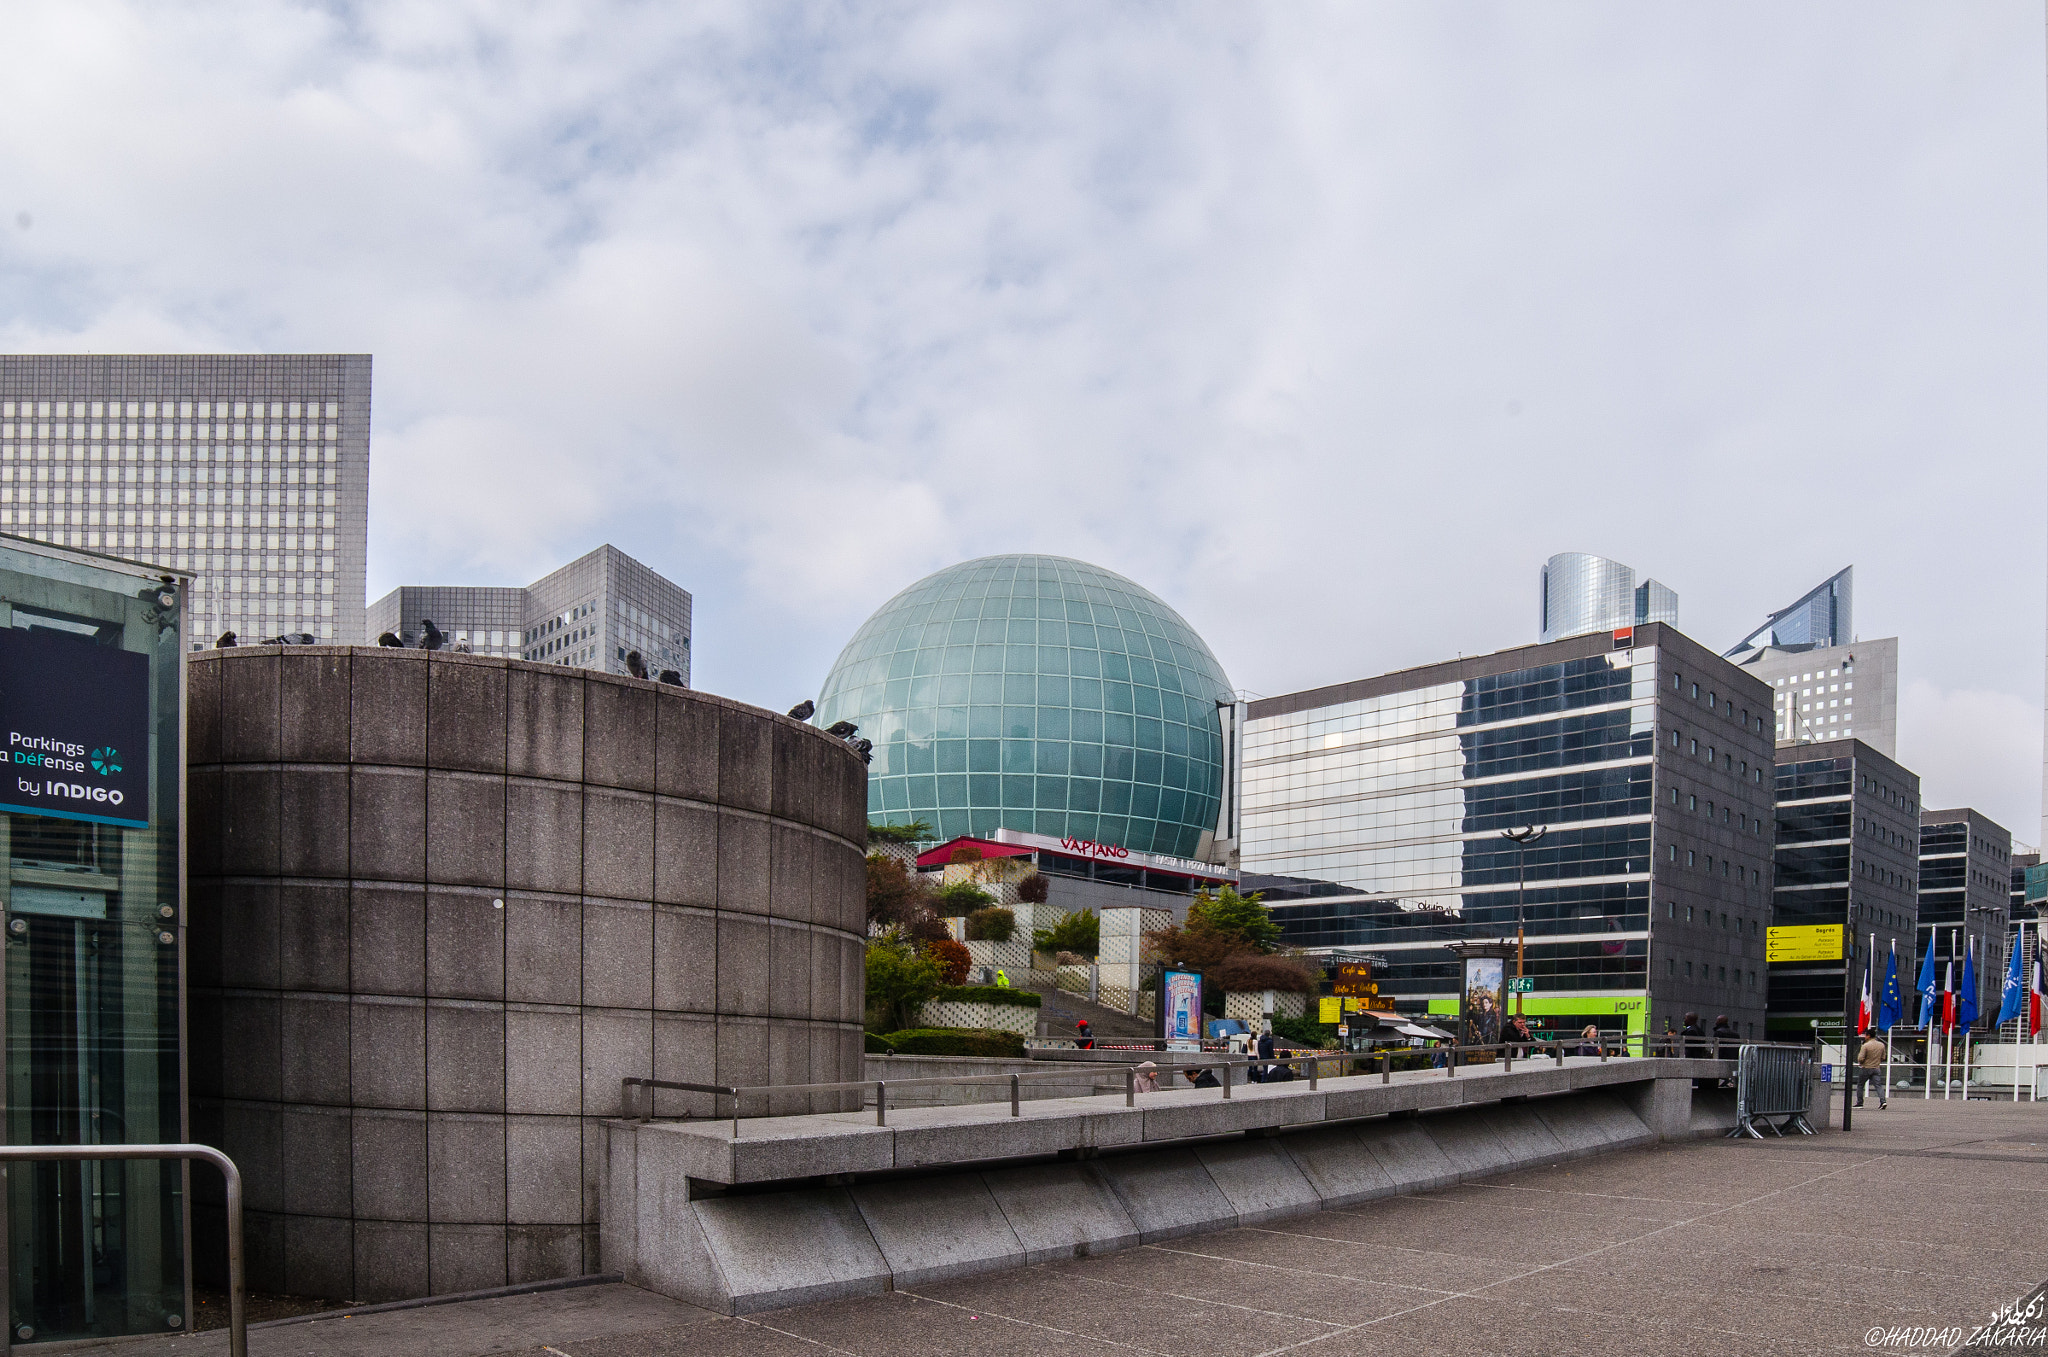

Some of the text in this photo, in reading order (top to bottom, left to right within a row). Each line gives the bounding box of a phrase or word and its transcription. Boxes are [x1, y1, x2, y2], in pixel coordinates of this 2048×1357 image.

[10, 731, 85, 757] Parkings
[0, 750, 85, 773] a Défense
[18, 776, 124, 806] by INDIGO
[1155, 854, 1179, 867] PASTA
[1186, 860, 1206, 872] PIZZA
[1214, 865, 1229, 875] BAR
[1614, 1000, 1642, 1013] jour
